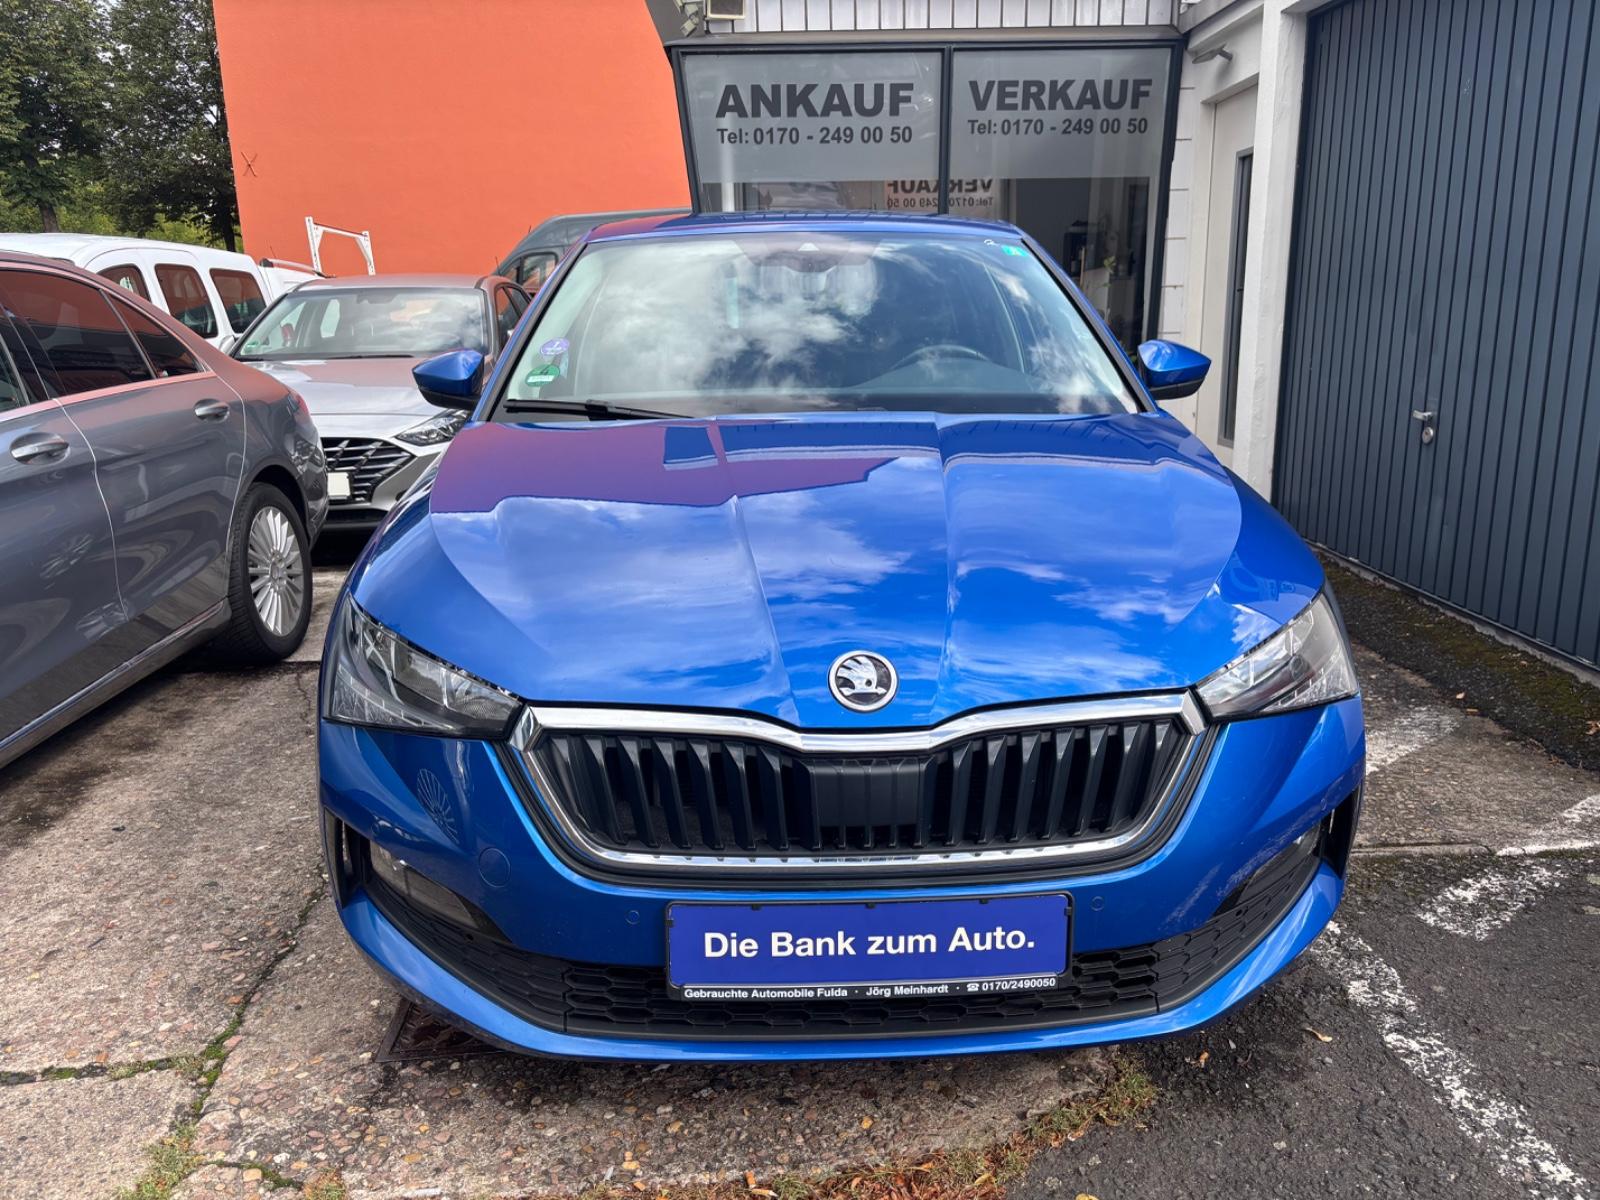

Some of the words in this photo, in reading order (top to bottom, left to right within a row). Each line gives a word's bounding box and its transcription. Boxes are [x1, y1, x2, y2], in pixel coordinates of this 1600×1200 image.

[715, 83, 914, 118] ANKAUF
[968, 79, 1152, 111] VERKAUF
[716, 128, 749, 144] Tel:
[753, 127, 800, 144] 0170
[819, 127, 854, 144] 249
[860, 127, 883, 144] 00
[890, 126, 912, 143] 50
[967, 119, 997, 135] Tel:
[1001, 119, 1044, 135] 0170
[1061, 118, 1094, 135] 249
[1100, 118, 1121, 134] 00
[1127, 118, 1148, 134] 50
[704, 931, 759, 958] Die
[771, 929, 856, 957] Bank
[867, 933, 937, 955] zum
[948, 926, 1034, 952] Auto.
[684, 988, 748, 998] Gebrauchte
[751, 987, 815, 998] Automobile
[817, 987, 848, 997] Fulda
[866, 986, 891, 997] Jörg
[894, 984, 949, 996] Meinhardt
[982, 977, 1056, 991] 0170/2490050
